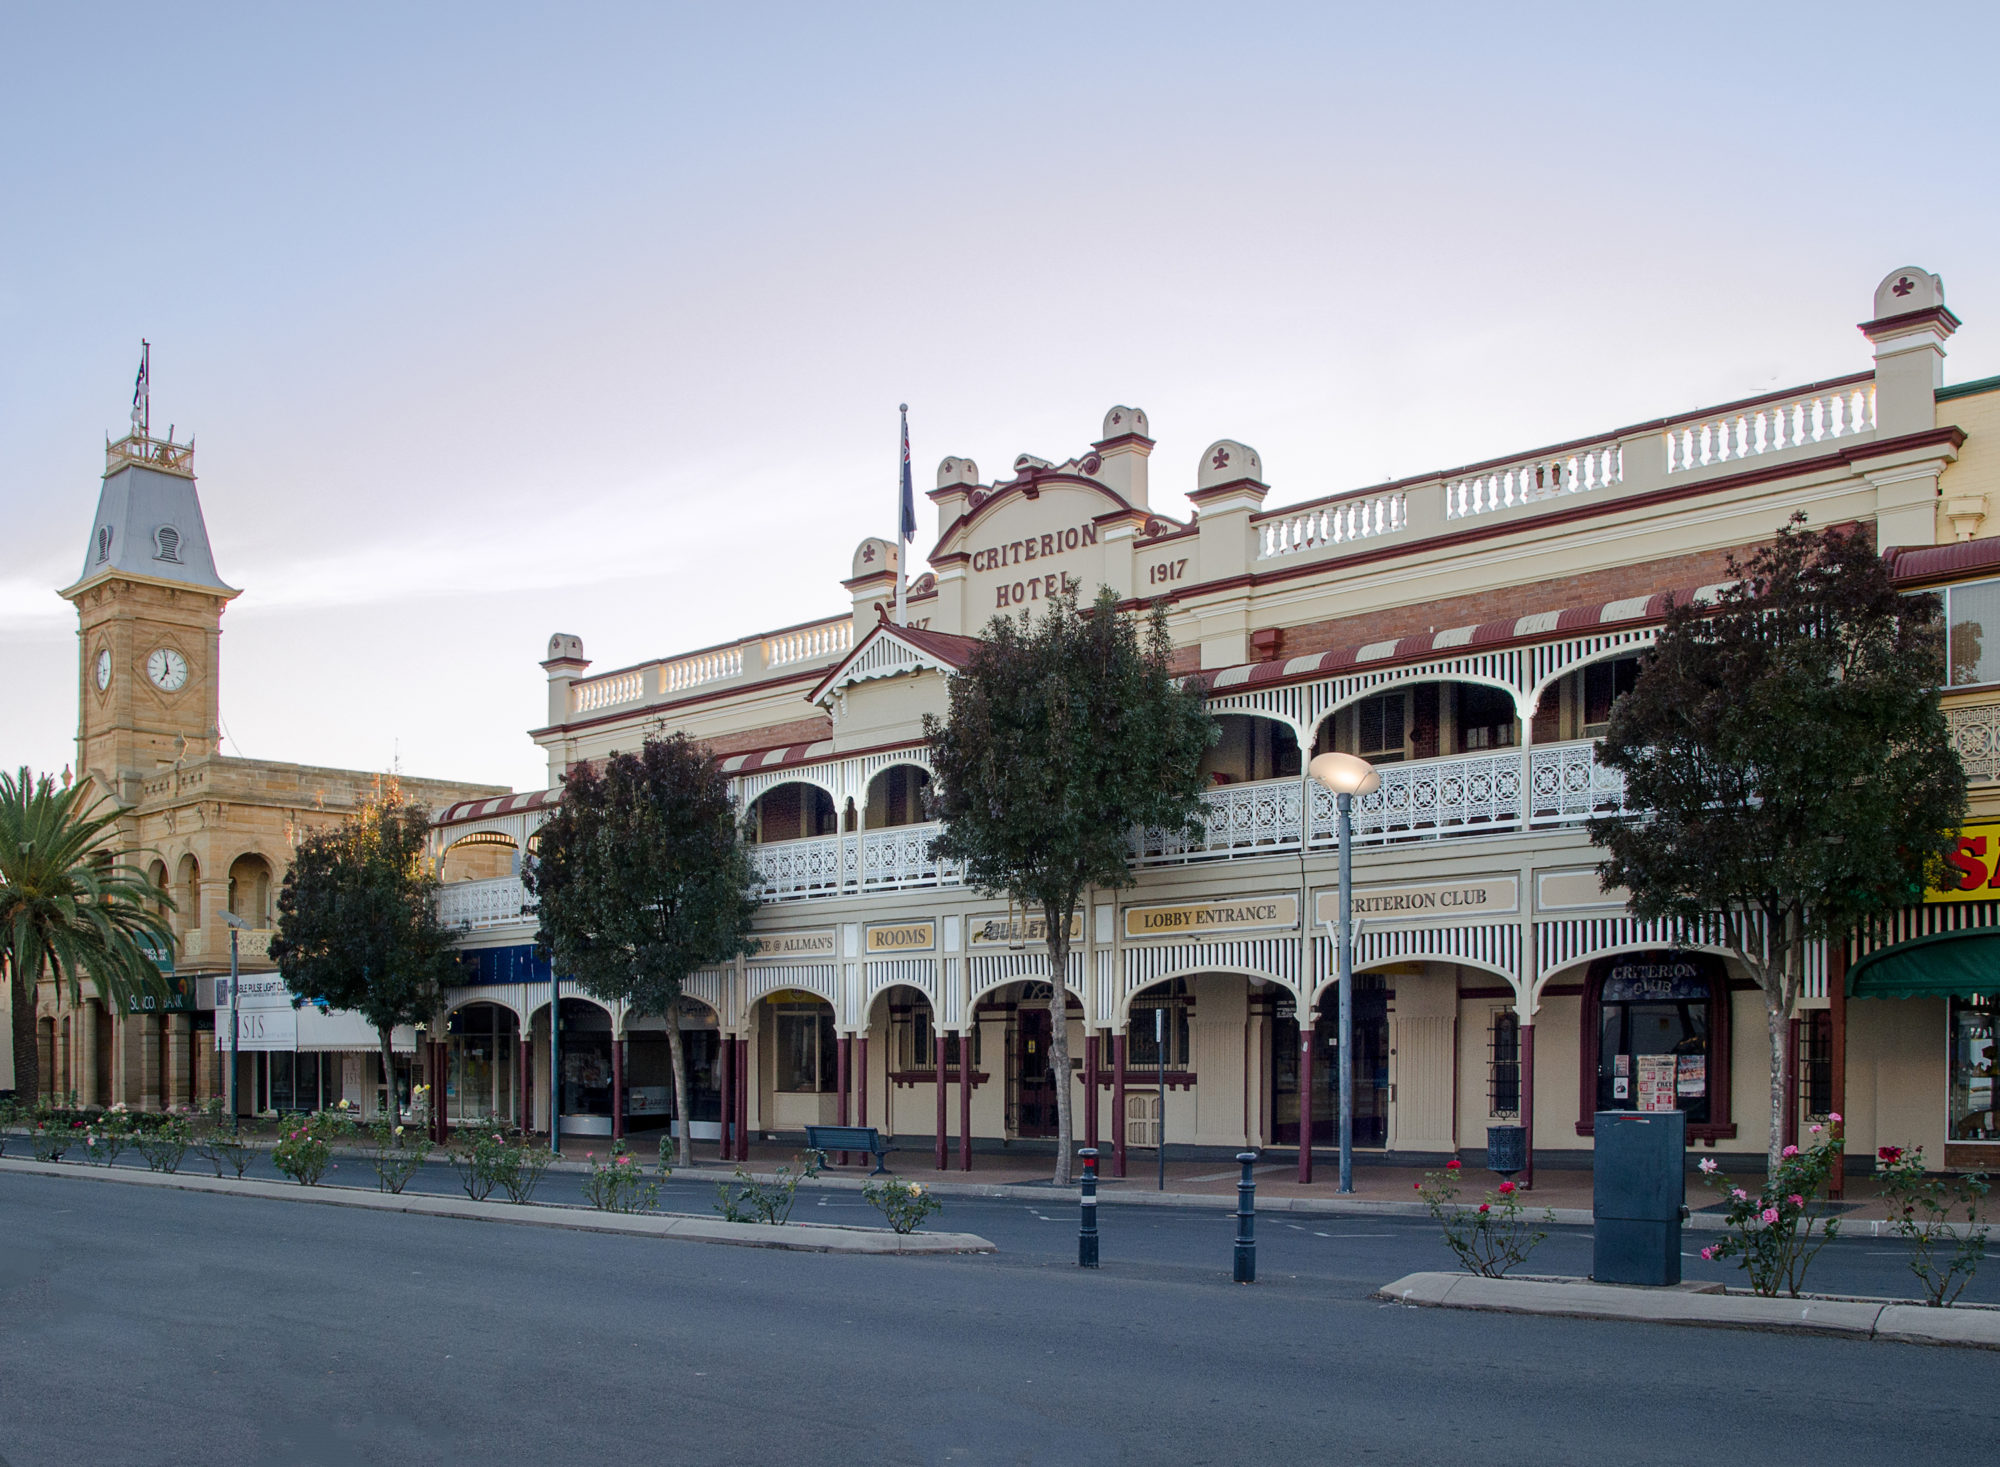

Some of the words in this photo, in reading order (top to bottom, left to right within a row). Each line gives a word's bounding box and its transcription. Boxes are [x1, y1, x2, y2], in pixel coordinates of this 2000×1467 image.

[973, 522, 1097, 572] CRITERION
[1150, 558, 1188, 585] 1917
[996, 571, 1069, 608] HOTEL
[1440, 889, 1486, 907] CLUB
[1144, 911, 1192, 928] LOBBY
[1196, 904, 1277, 925] ENTRANCE
[784, 936, 833, 951] ALLMAN'S
[876, 928, 926, 947] ROOMS
[1612, 963, 1697, 980] CRITERION
[1634, 980, 1672, 995] CLUB
